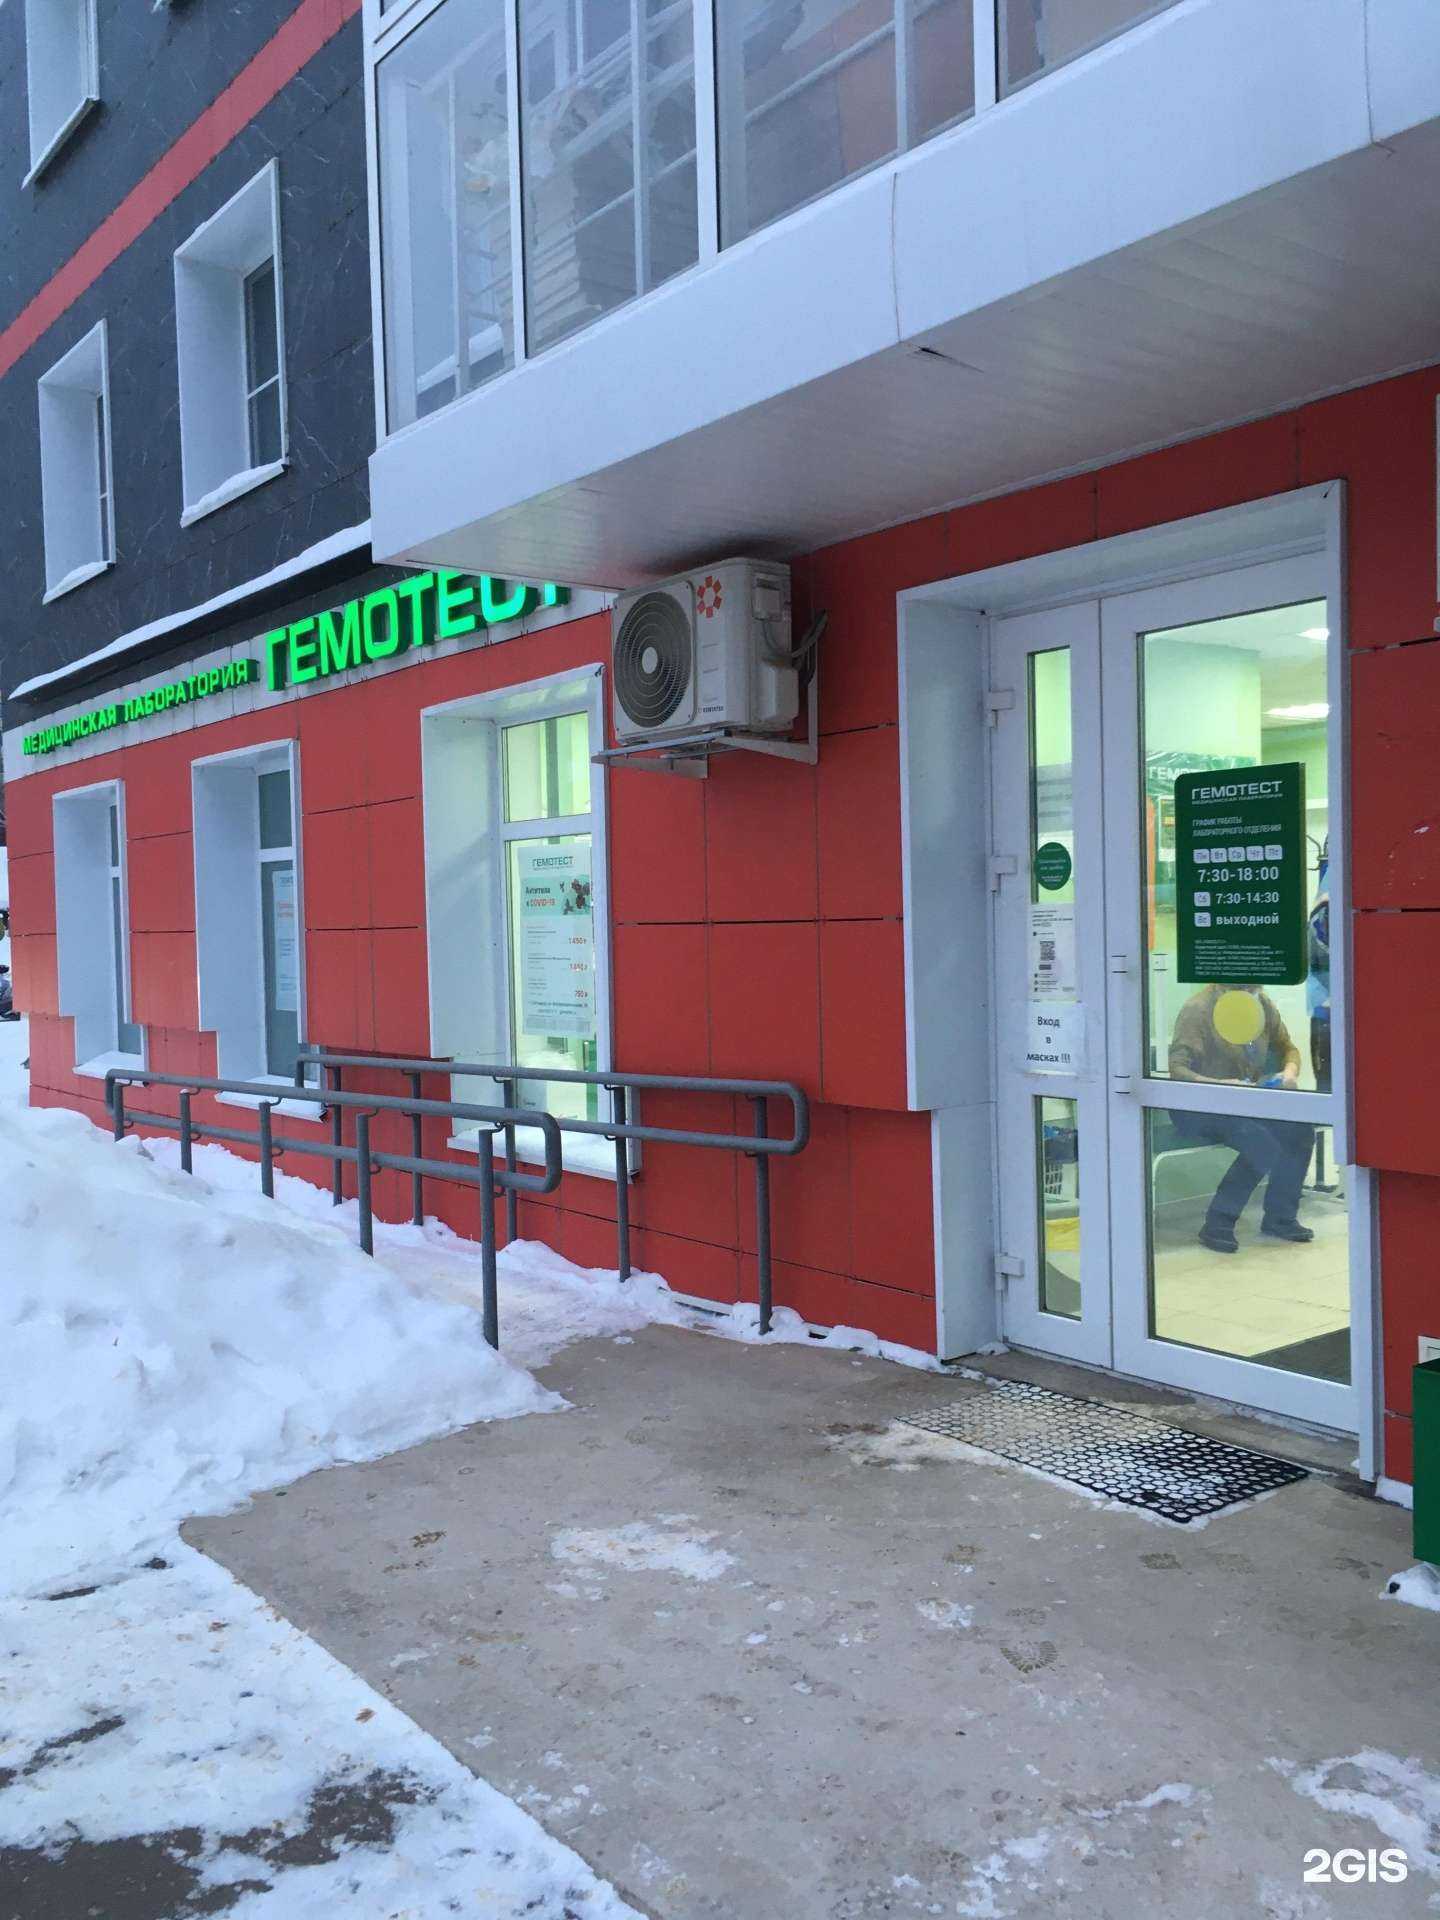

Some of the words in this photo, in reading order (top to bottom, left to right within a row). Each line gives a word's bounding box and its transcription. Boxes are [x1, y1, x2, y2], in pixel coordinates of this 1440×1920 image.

[23, 705, 117, 755] МЕДИЦИНСКАЯ
[124, 658, 250, 722] ЛАБОРАТОРИЯ
[264, 569, 557, 692] ГЕМОТЕС
[1192, 781, 1283, 800] ГЕМОТЕСТ
[1192, 818, 1216, 827] ГРАФИК
[1217, 816, 1242, 825] РАБОТЫ
[1193, 827, 1243, 837] ЛАБОРАТОРНОГО
[1244, 824, 1282, 834] ОТДЕЛЕНИЯ
[532, 856, 574, 867] ГЕМОТЕСТ
[1215, 892, 1280, 904] 7:30-14:30
[1216, 912, 1279, 927] выходной
[1037, 1016, 1060, 1028] Вход
[1045, 1036, 1052, 1044] в
[1026, 1053, 1059, 1062] масках
